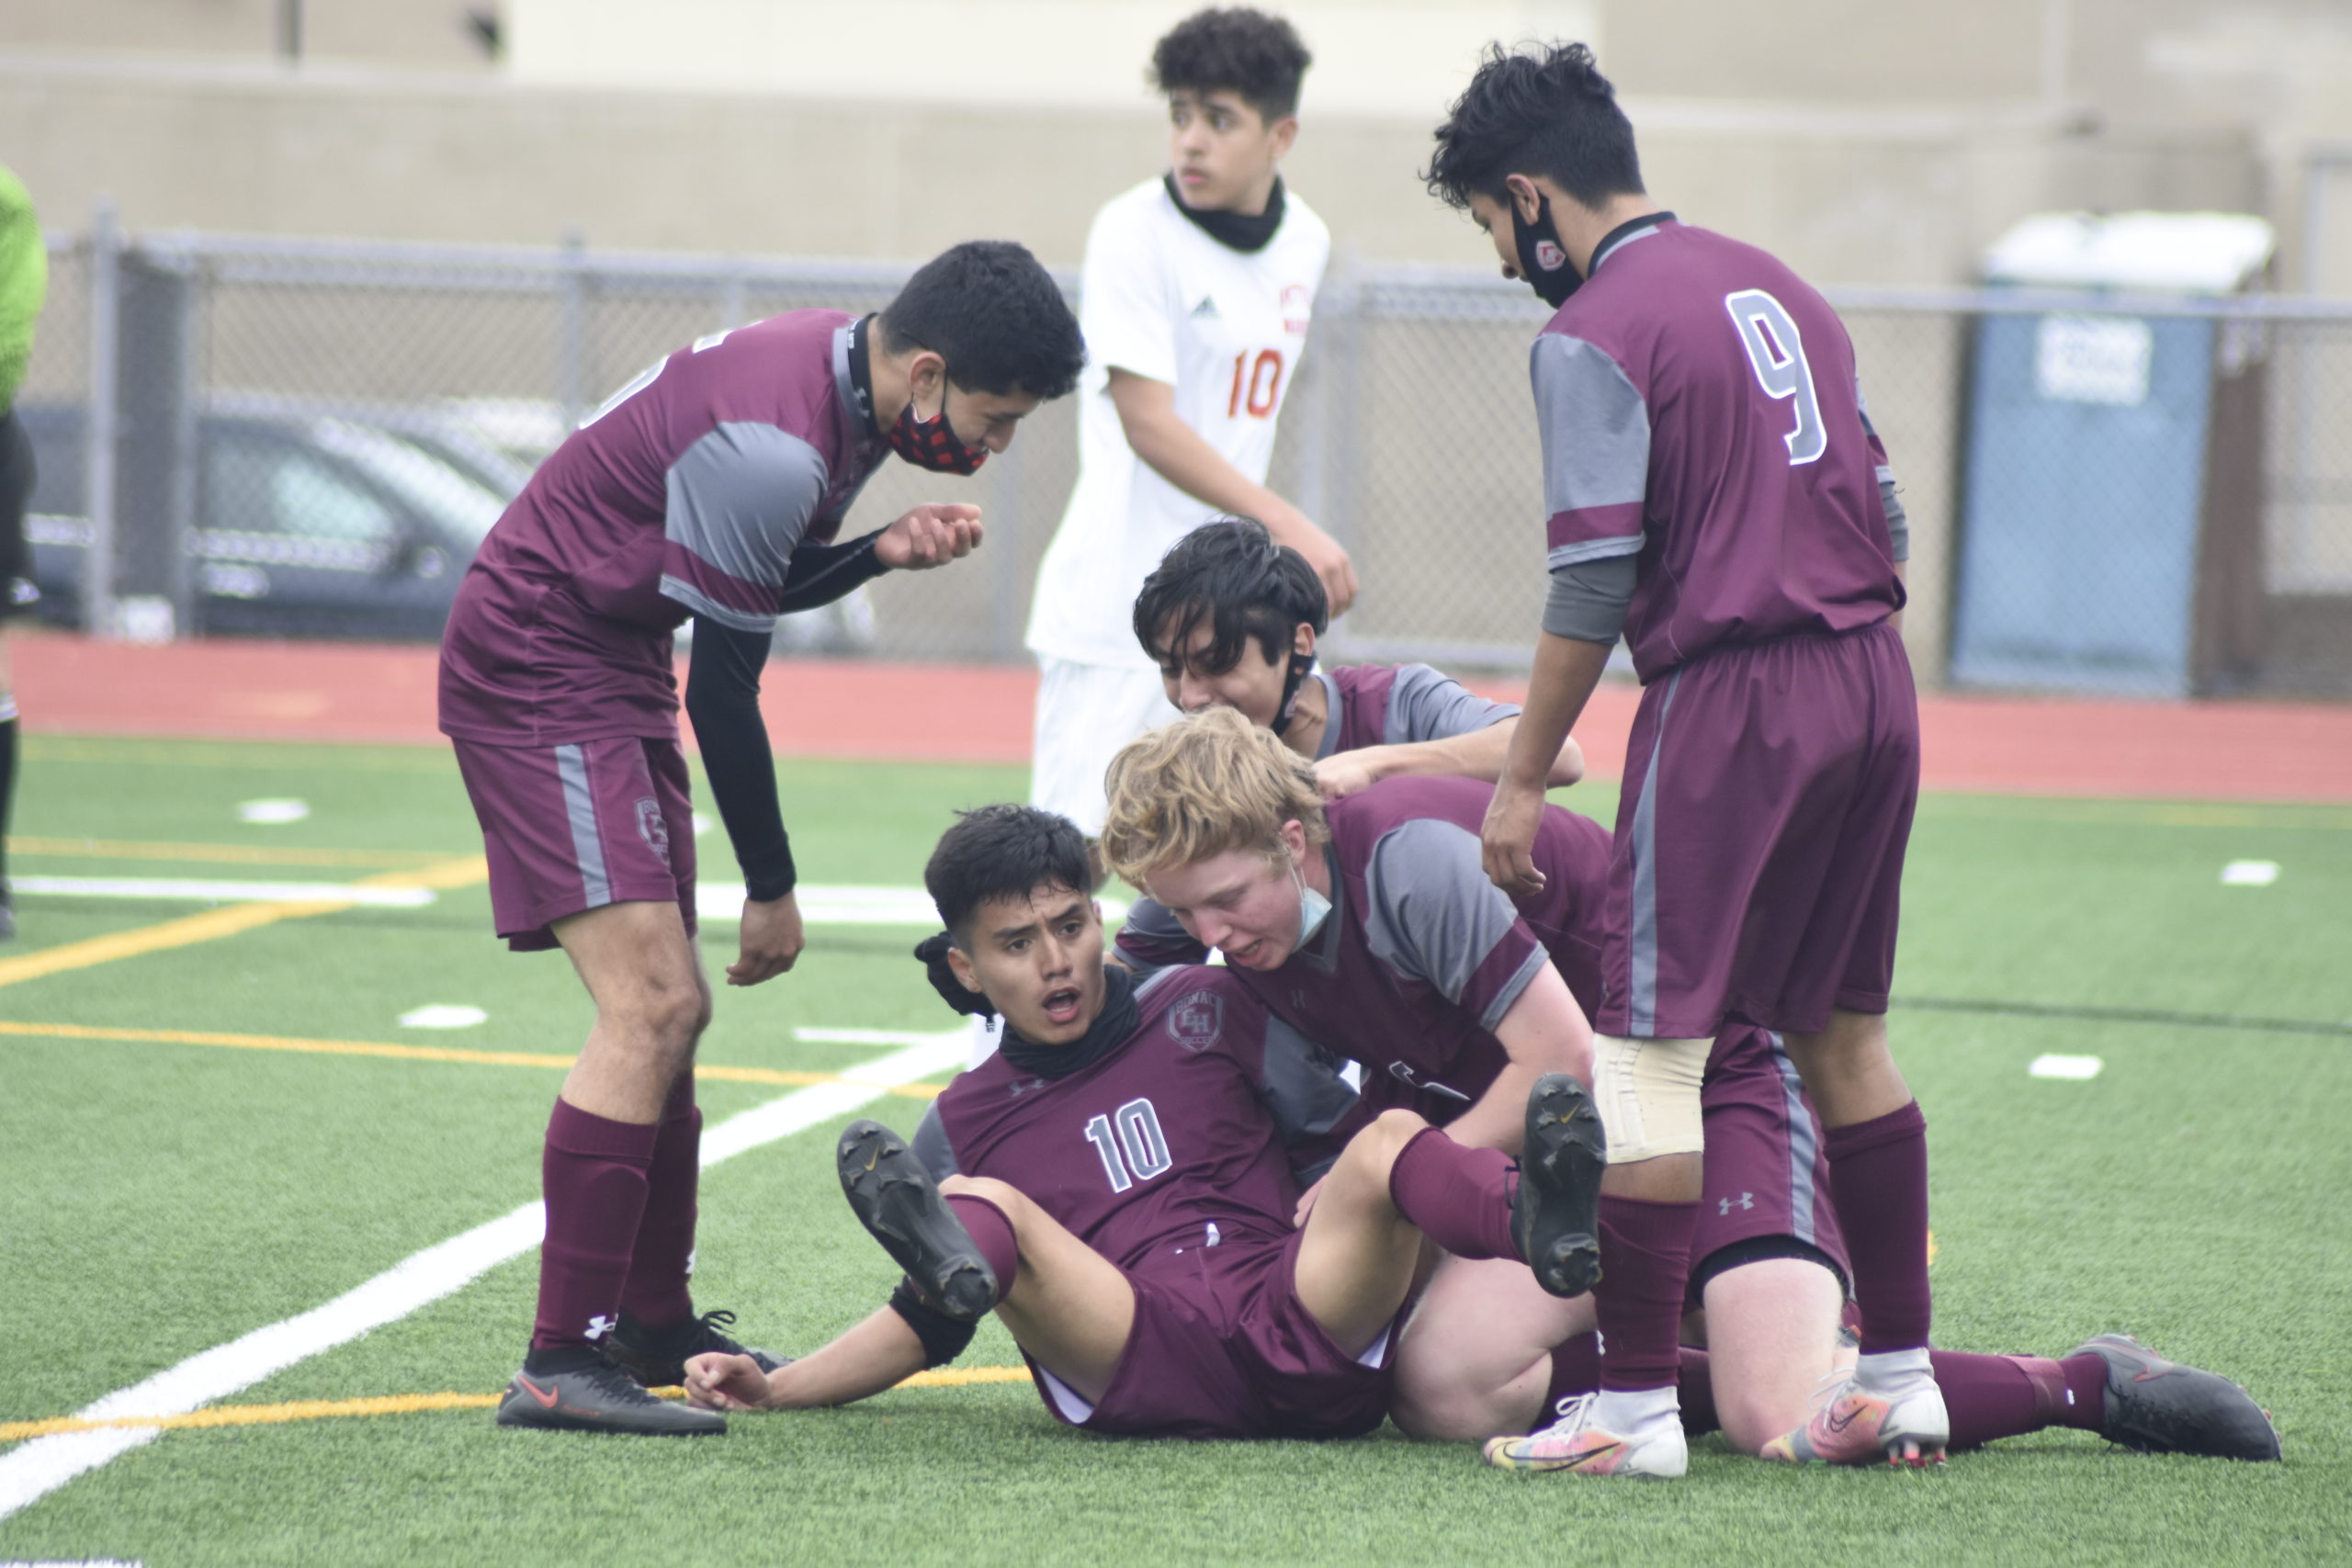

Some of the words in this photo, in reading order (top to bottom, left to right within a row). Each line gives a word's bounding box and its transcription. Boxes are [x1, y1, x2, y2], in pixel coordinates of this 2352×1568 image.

[1228, 348, 1283, 420] 10
[1725, 288, 1827, 466] 9
[1175, 991, 1217, 1015] BONAC
[1180, 1007, 1210, 1032] EH
[1181, 1035, 1215, 1044] SOCCER
[1084, 1098, 1173, 1193] 10
